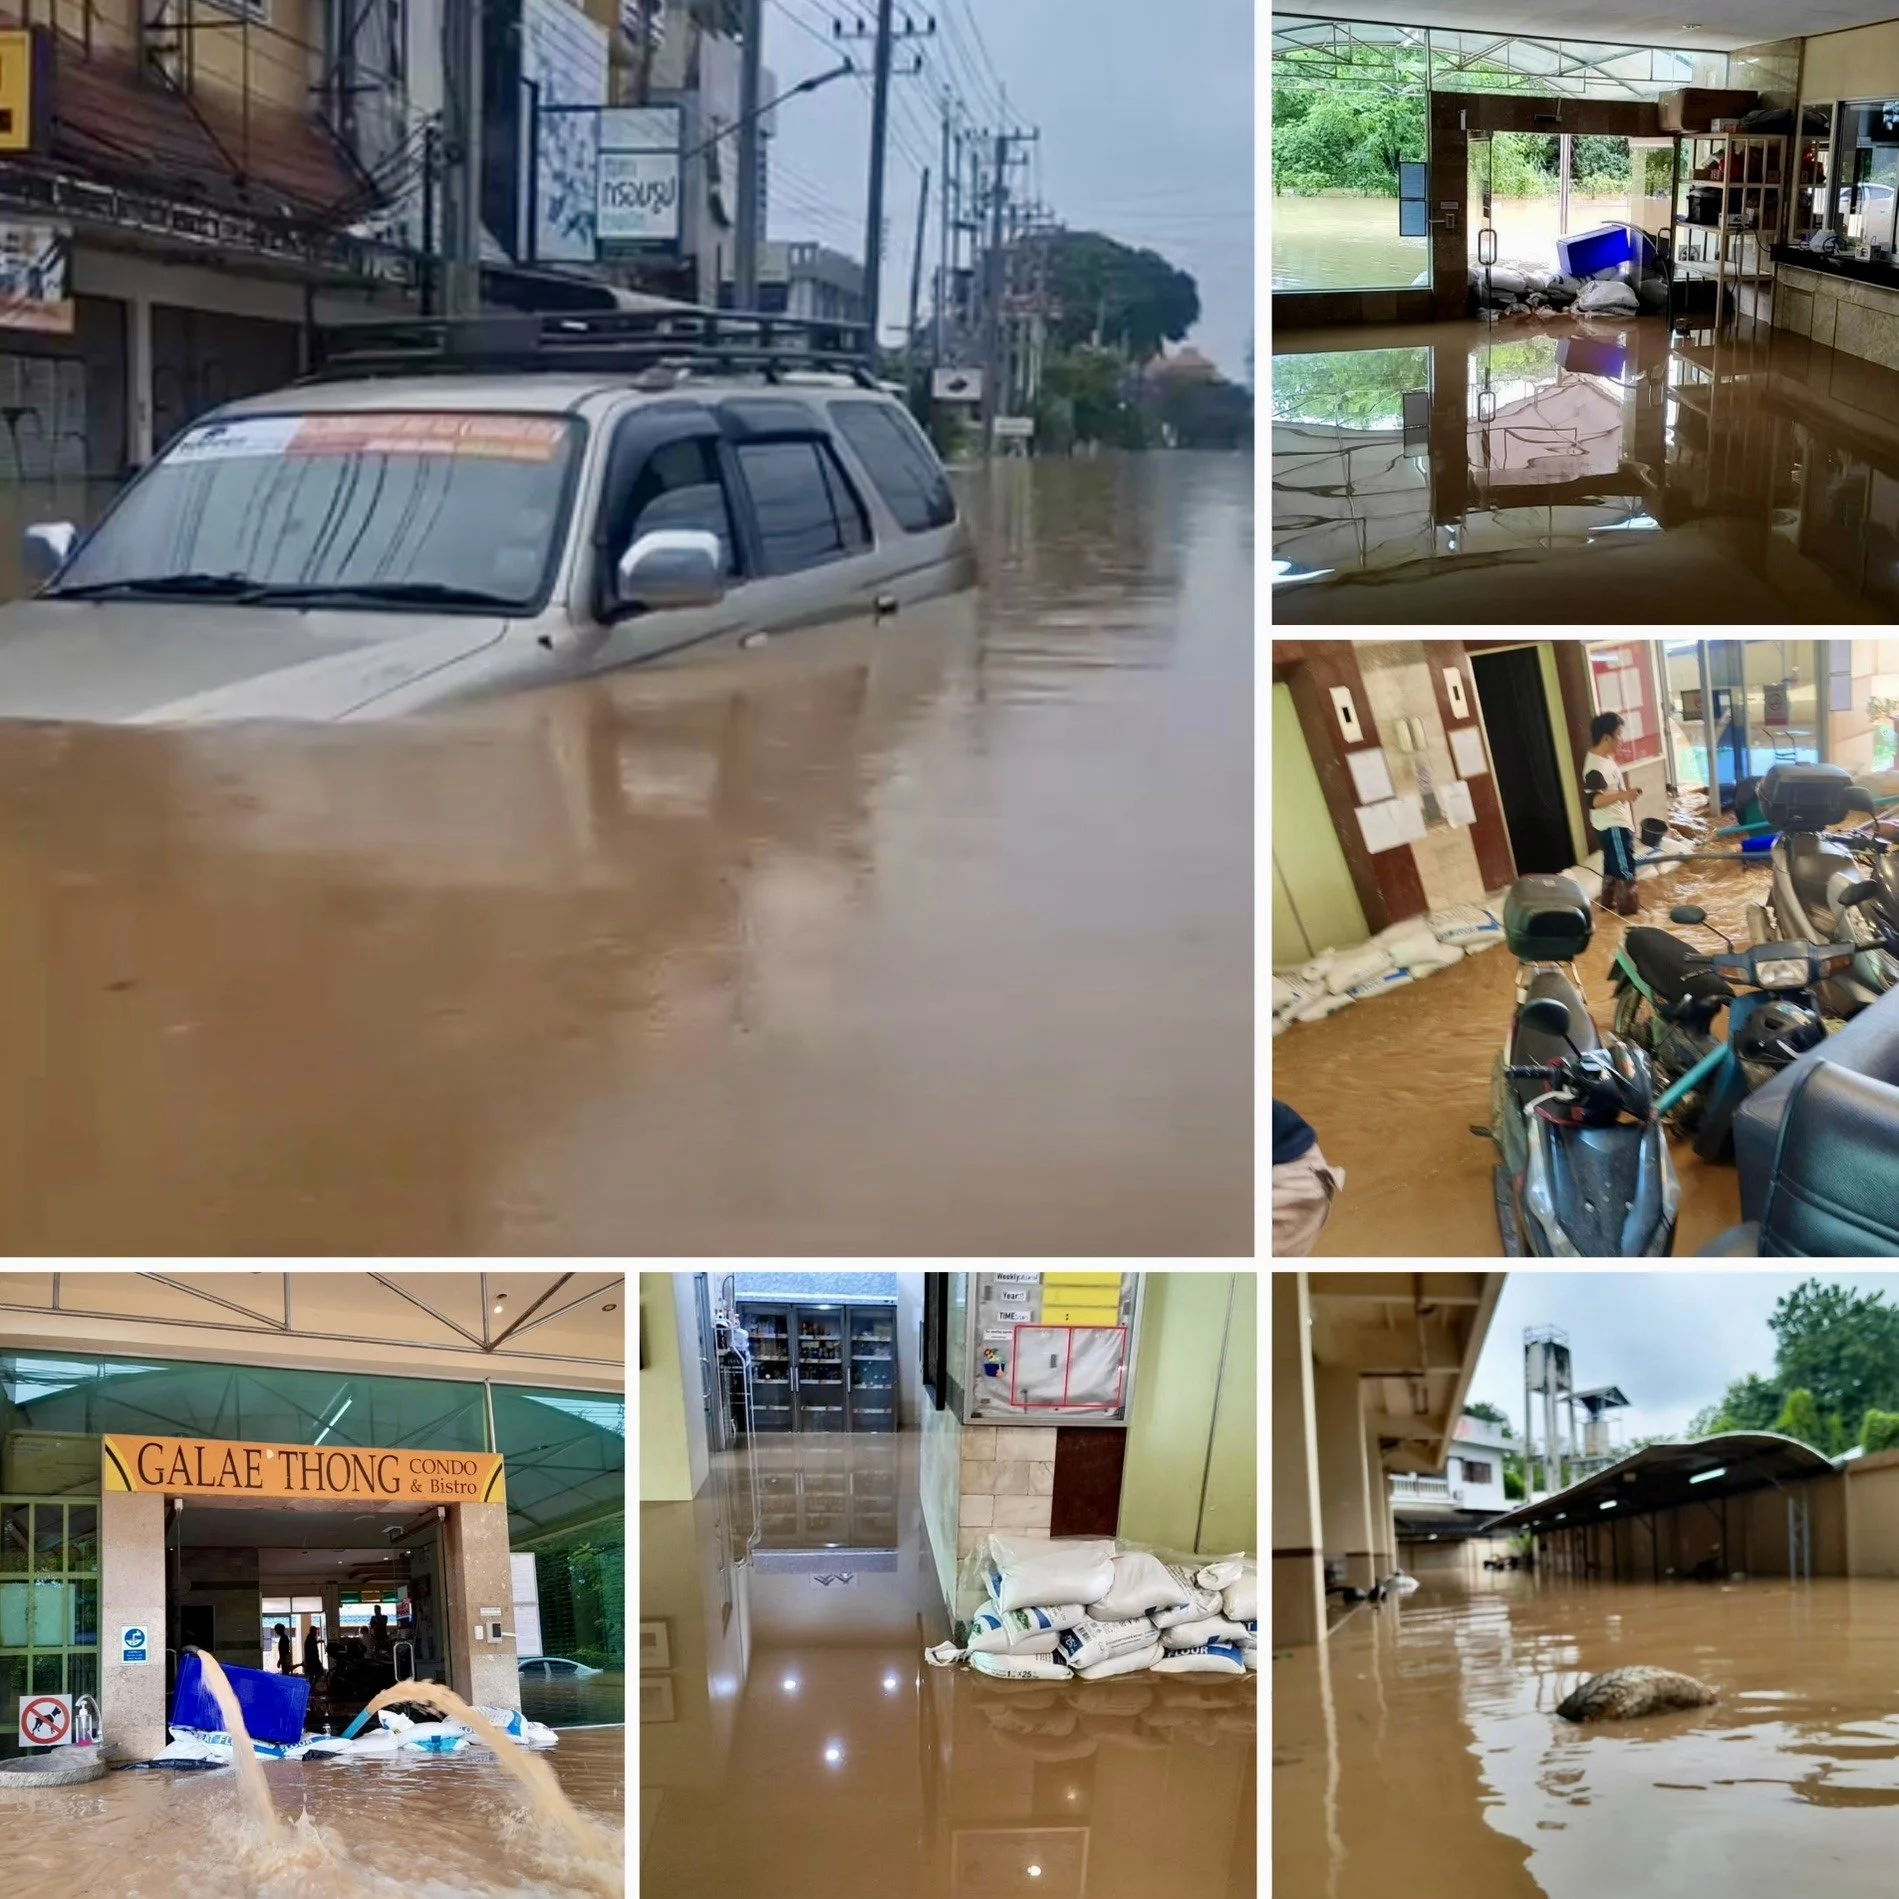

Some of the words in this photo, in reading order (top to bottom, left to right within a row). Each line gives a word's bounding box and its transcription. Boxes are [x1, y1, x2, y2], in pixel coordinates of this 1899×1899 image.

[138, 1442, 263, 1489] GALAE
[278, 1450, 400, 1494] THONG
[409, 1458, 477, 1475] CONDO
[410, 1479, 422, 1493] &
[431, 1478, 477, 1495] Bistro
